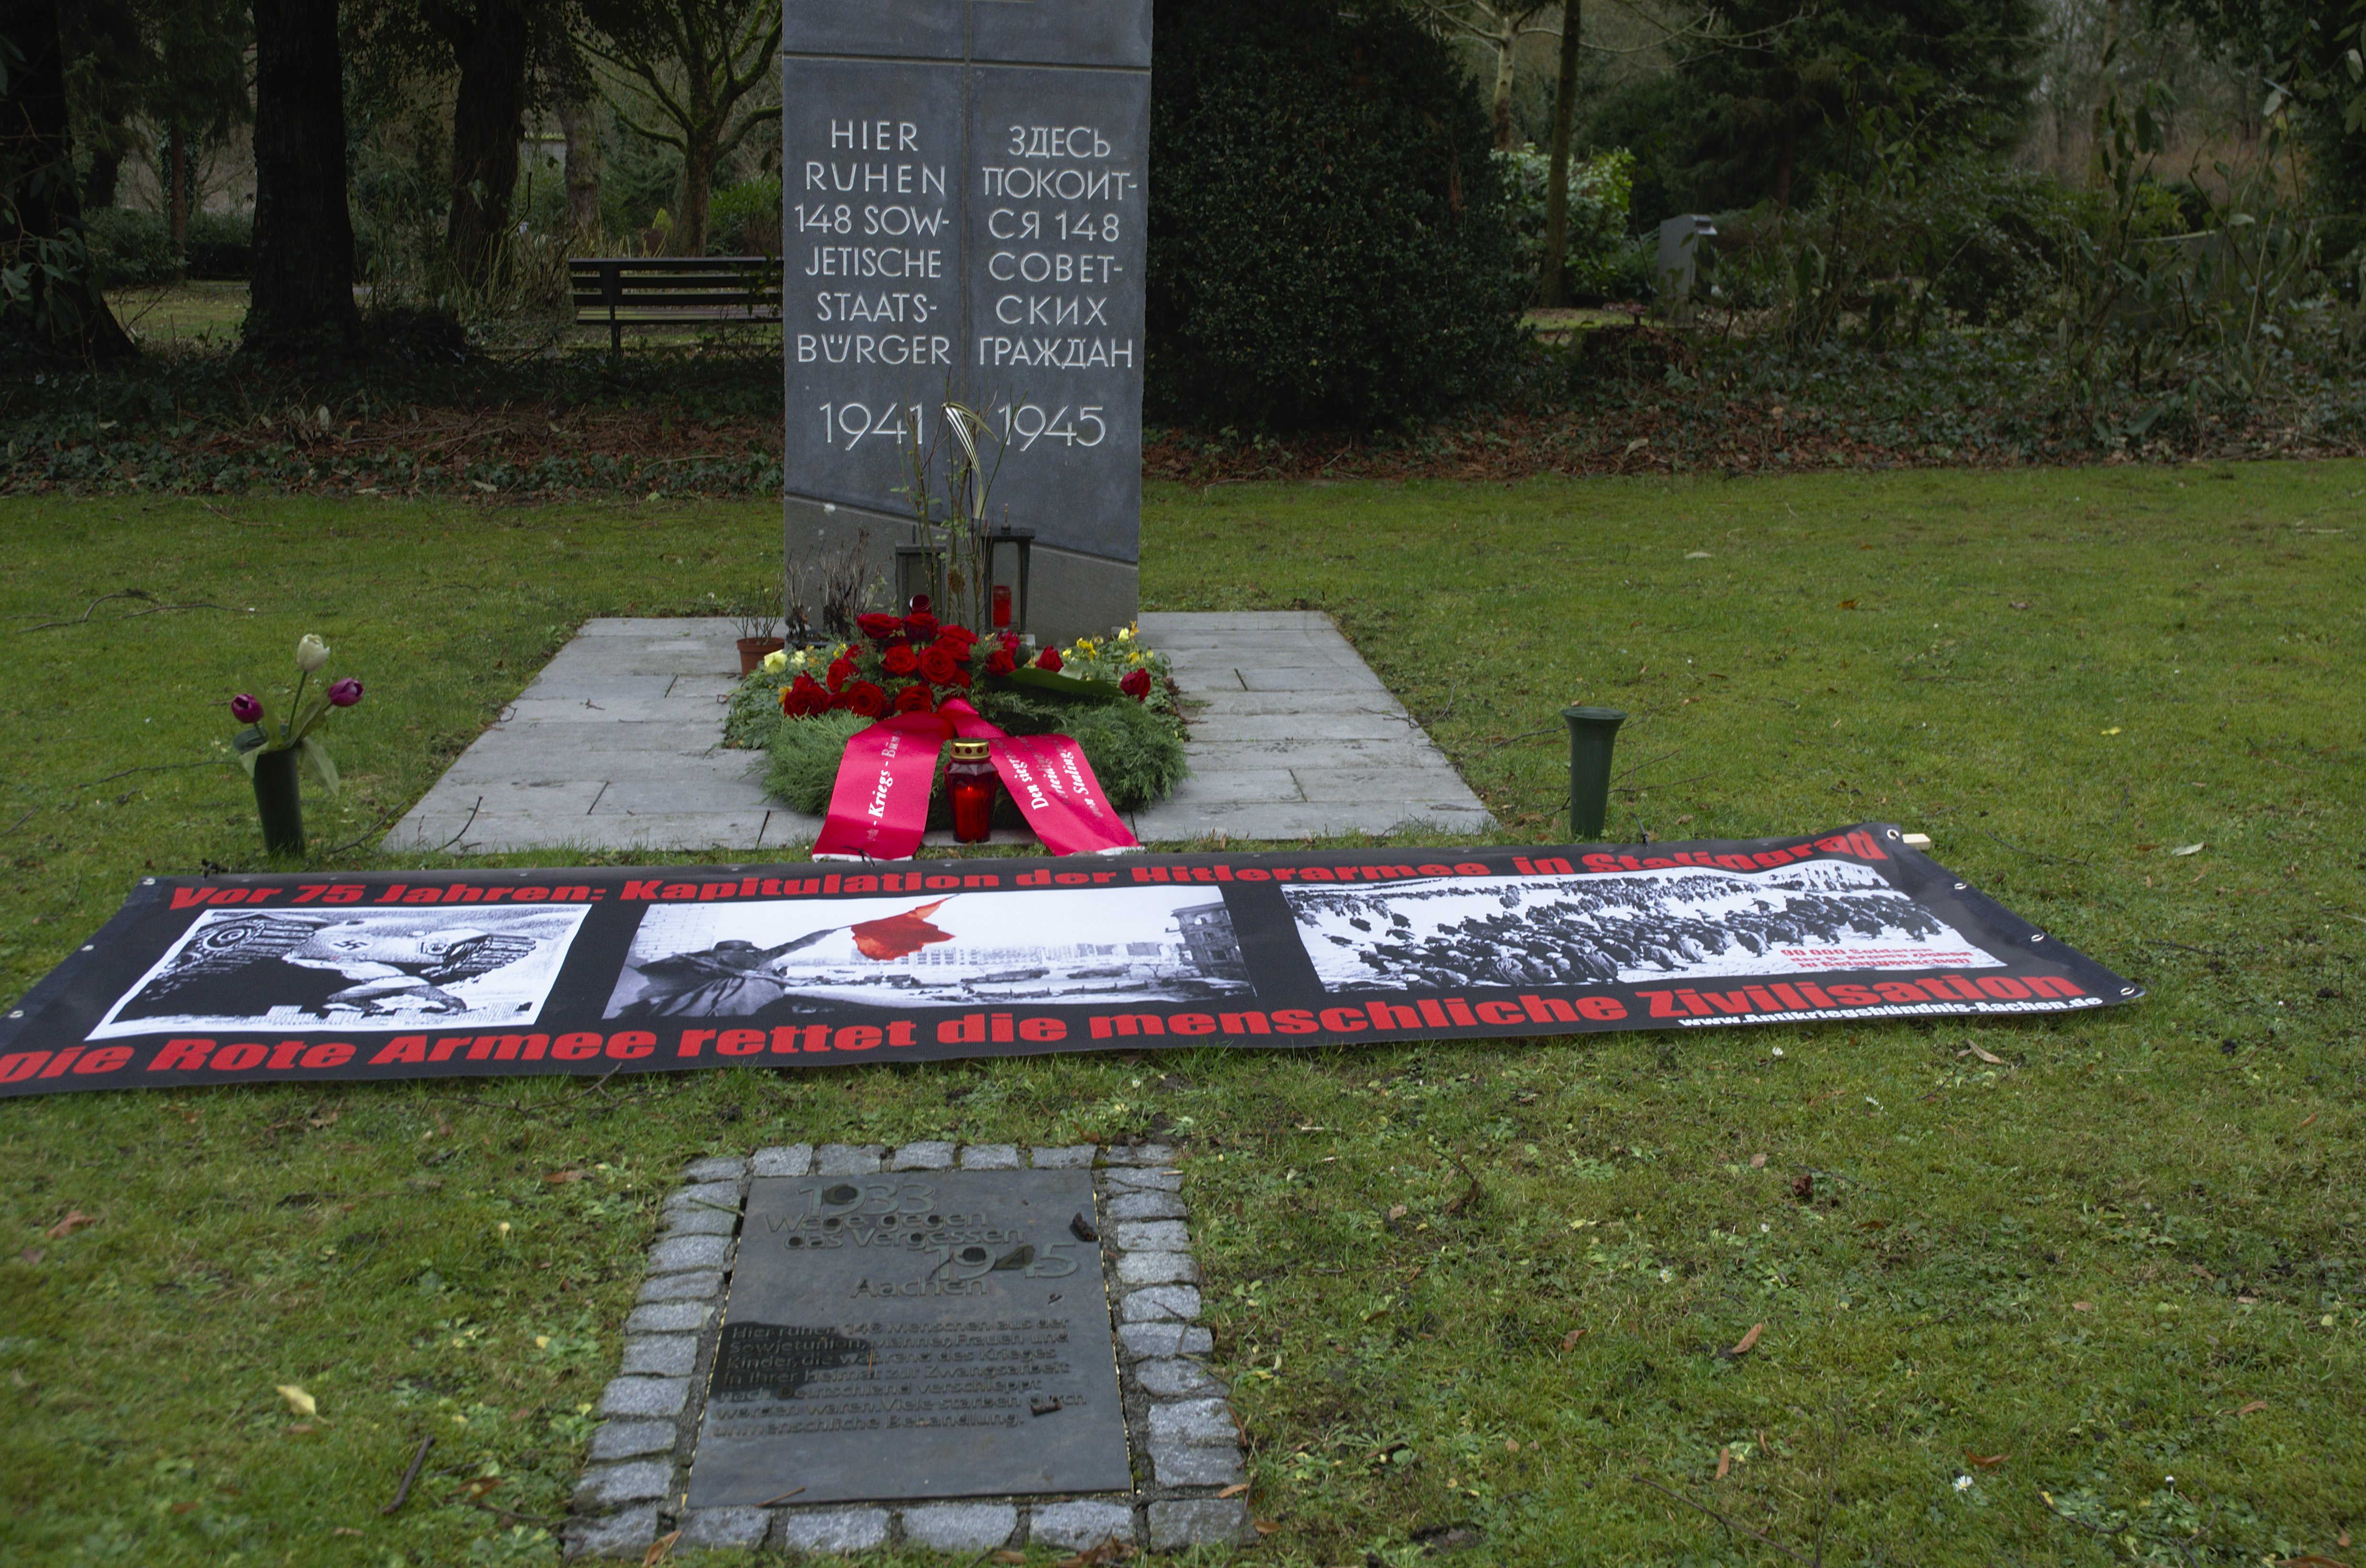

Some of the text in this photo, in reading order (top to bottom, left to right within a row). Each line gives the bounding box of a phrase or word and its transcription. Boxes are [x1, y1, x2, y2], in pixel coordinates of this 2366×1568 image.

[830, 118, 918, 152] HIER
[1008, 125, 1111, 159] ЗДЕСЬ
[806, 161, 946, 195] RUHEN
[982, 166, 1138, 200] ПОКОИТ-
[794, 202, 950, 237] 148 SOW-
[988, 208, 1120, 243] СЯ 148
[805, 246, 941, 278] JETISCHE
[988, 251, 1123, 283] СОВЕТ-
[817, 291, 937, 323] STAATS-
[995, 294, 1107, 326] СКИХ
[797, 333, 952, 365] BÜRGER
[979, 336, 1133, 370] ГРАЖДАН
[819, 401, 924, 452] 1941
[997, 402, 1107, 452] 1945
[868, 769, 893, 818] Kriegs
[1027, 784, 1049, 810] Den
[169, 830, 1889, 911] Vor 75 Jahren: Kapitulation der Hitlerarmee in Stalingrad
[0, 974, 2087, 1084] Die Rote Armee rettet die menschliche Zivilisation
[797, 1182, 937, 1217] 1933
[766, 1211, 989, 1234] Wege gegen
[783, 1227, 1025, 1250] das Vergessen
[924, 1243, 1079, 1282] 1945
[850, 1276, 989, 1299] Aachen
[728, 1337, 868, 1355] Sowjetunion,
[956, 1334, 1024, 1347] Frauen
[1031, 1332, 1070, 1345] und
[732, 1317, 1069, 1339] Hier ruhen 148 Menschen aus der
[723, 1371, 742, 1386] in
[804, 1367, 881, 1382] Heimat
[886, 1368, 920, 1380] zur
[924, 1361, 1071, 1379] Zwangsarbeit
[727, 1356, 798, 1369] Kinder,
[802, 1353, 833, 1367] die
[938, 1349, 974, 1362] des
[980, 1347, 1057, 1362] Krieges
[719, 1378, 1042, 1403] nach Deutschland verschleppt
[881, 1396, 934, 1412] Viele
[939, 1394, 1020, 1410] starben
[711, 1416, 880, 1436] unmenschliche
